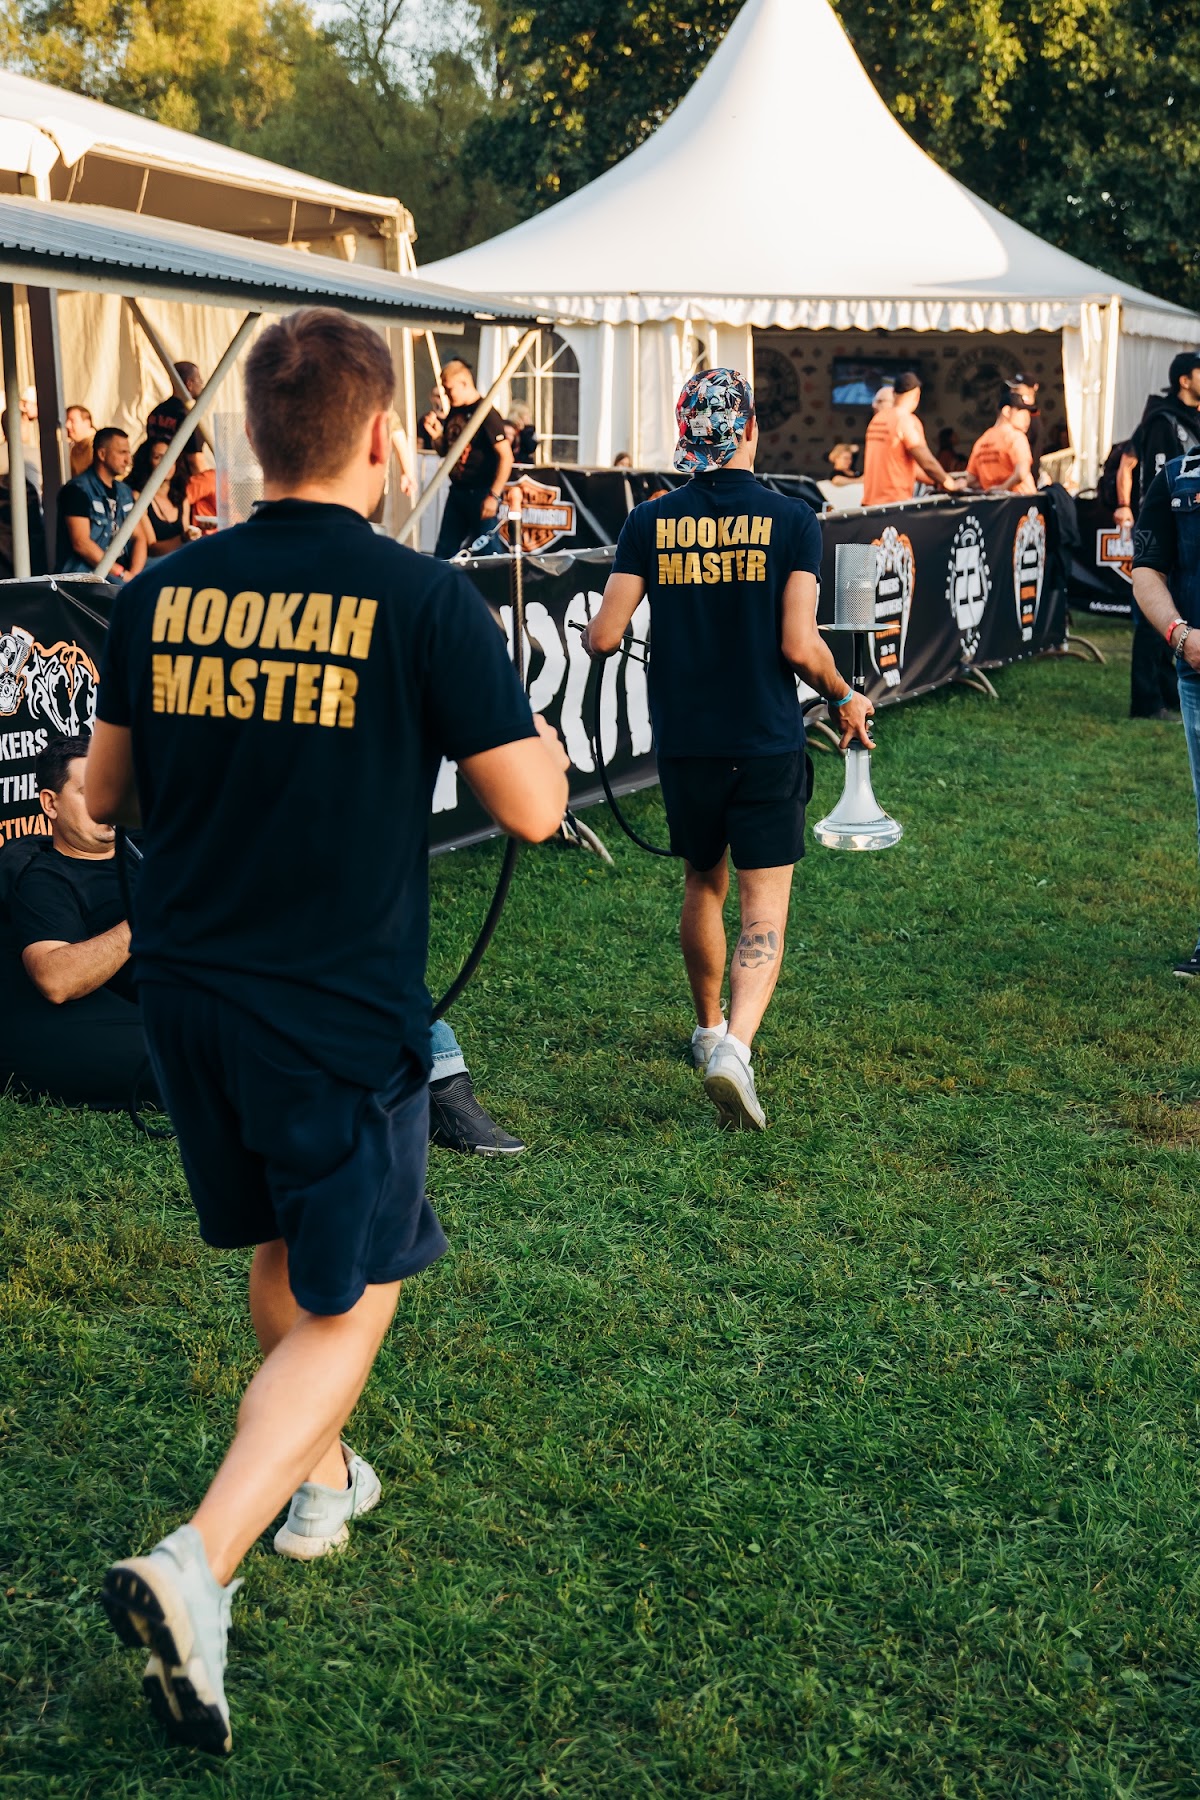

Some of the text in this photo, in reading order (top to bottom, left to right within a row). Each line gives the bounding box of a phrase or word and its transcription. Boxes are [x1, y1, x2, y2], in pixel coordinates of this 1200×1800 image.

[656, 514, 773, 549] HOOKAH
[657, 549, 767, 585] MASTER
[151, 586, 379, 660] HOOKAH
[152, 653, 359, 729] MASTER
